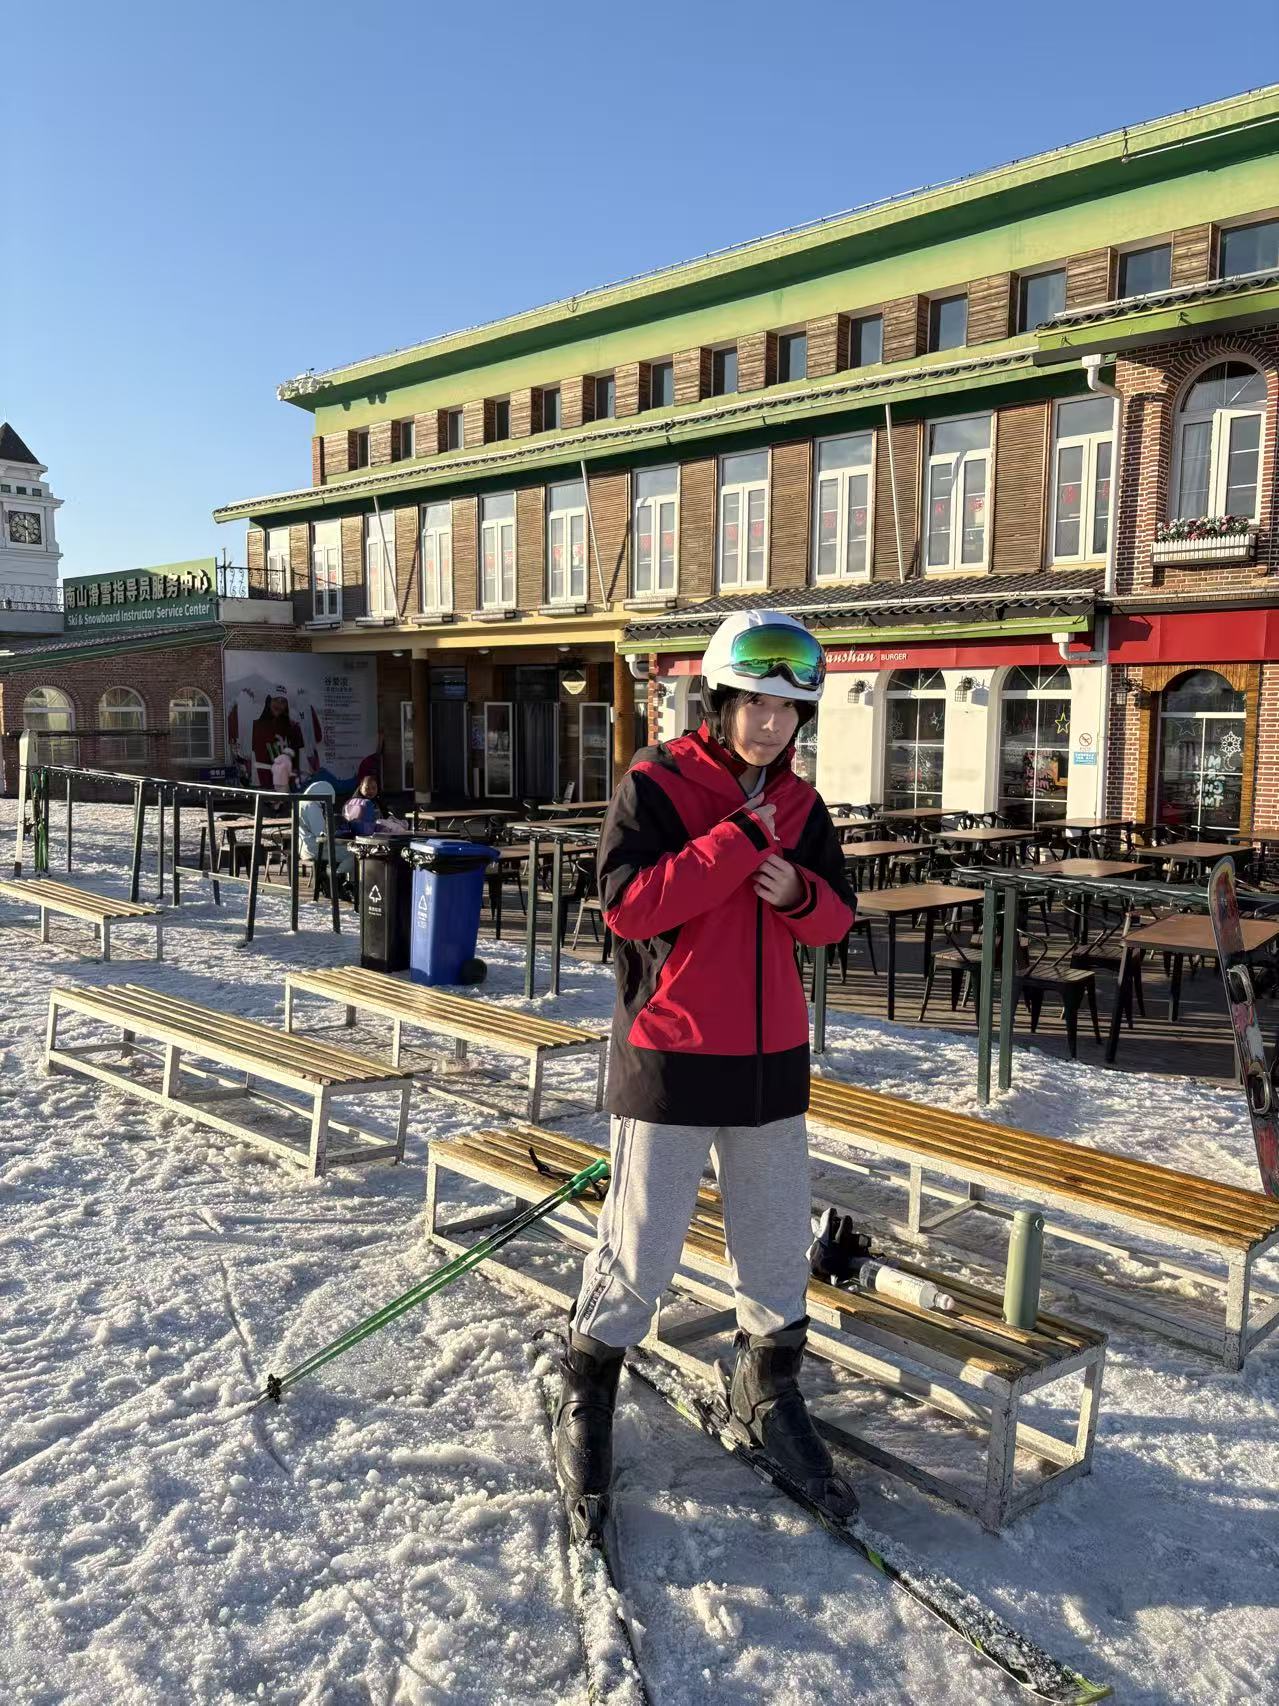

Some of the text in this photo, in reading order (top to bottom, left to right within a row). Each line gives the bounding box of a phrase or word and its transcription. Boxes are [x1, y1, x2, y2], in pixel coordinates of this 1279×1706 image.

[65, 569, 210, 609] 南山滑雪指导员服务中心
[68, 603, 210, 626] Ski & Snowboard Instructor Service Center
[825, 646, 907, 664] anshan BURGER
